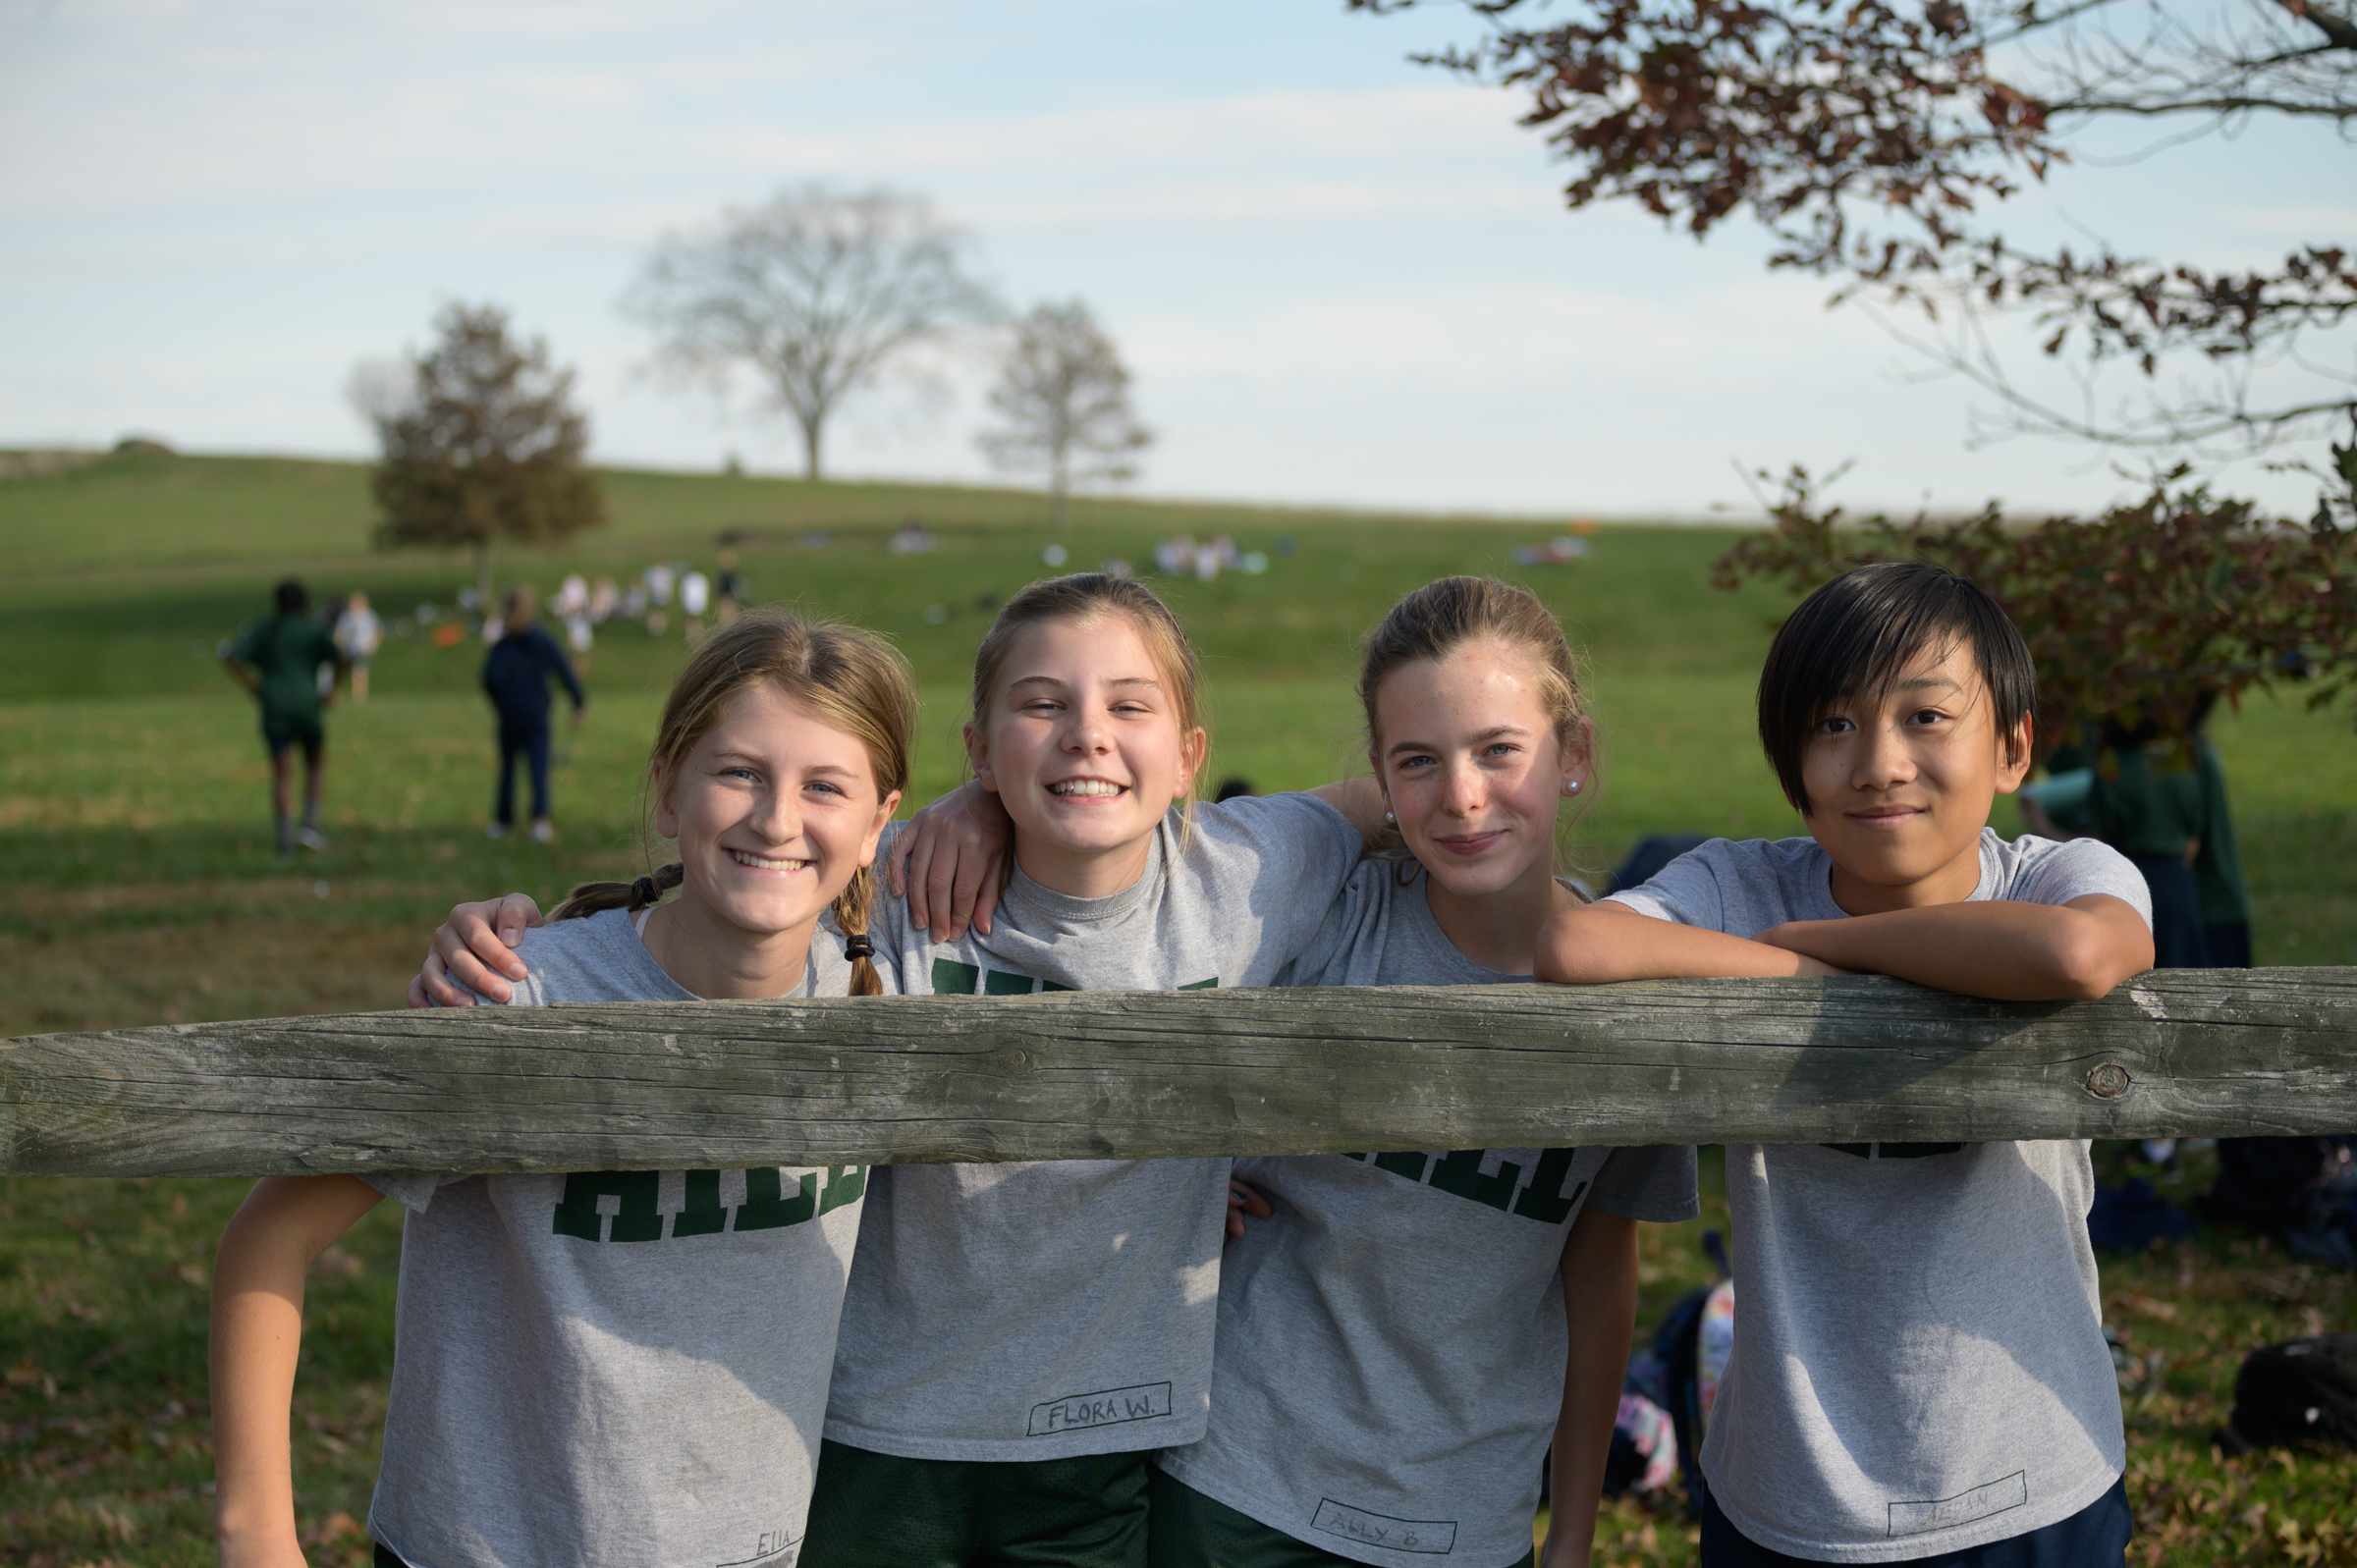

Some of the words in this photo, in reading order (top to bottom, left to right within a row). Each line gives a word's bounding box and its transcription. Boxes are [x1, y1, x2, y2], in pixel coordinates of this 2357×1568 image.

[1047, 1398, 1118, 1429] FLORA
[1124, 1394, 1156, 1418] W.
[1329, 1512, 1389, 1542] ALLY
[1403, 1531, 1419, 1545] B
